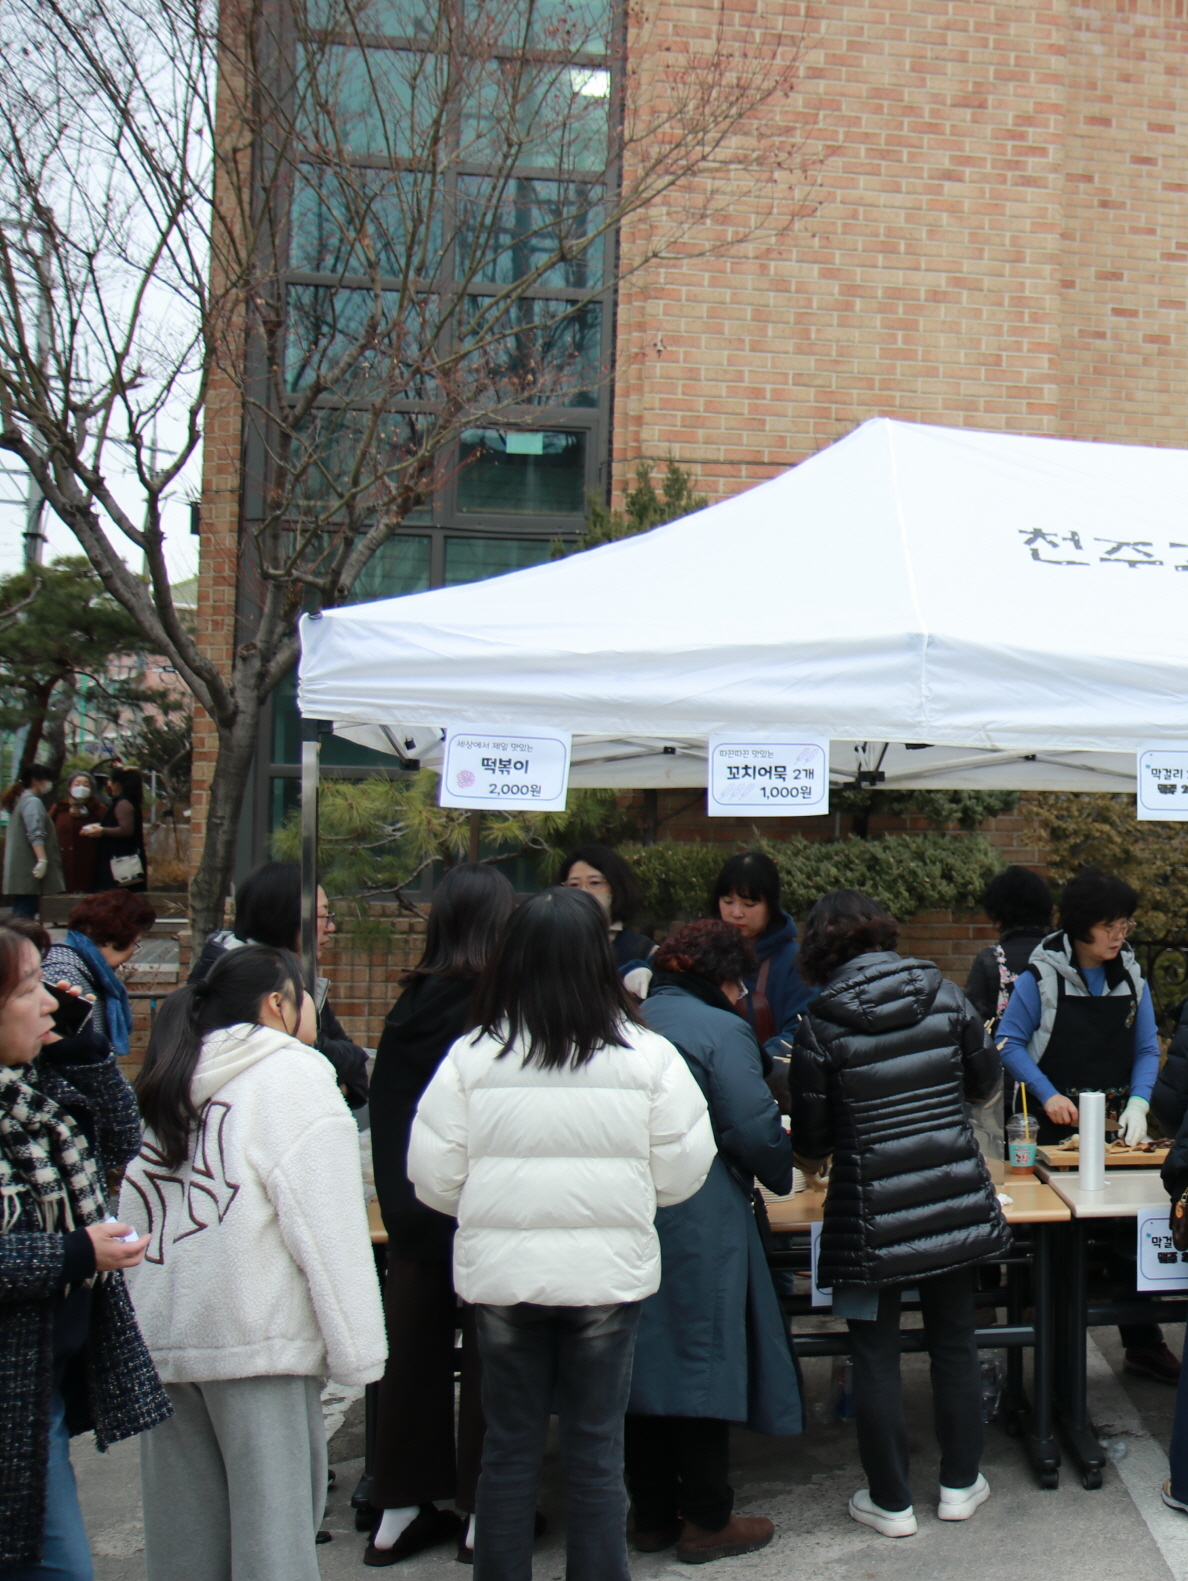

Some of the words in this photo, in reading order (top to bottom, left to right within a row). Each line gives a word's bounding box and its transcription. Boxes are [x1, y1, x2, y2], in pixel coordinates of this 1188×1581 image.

[457, 740, 490, 750] 세상에서
[492, 742, 508, 751] 제일
[510, 743, 534, 753] 맛있는
[719, 749, 749, 759] 따끈따끈
[751, 749, 774, 759] 맛있는
[481, 757, 529, 775] 떡볶이
[727, 765, 787, 782] 꼬치어묵
[793, 768, 814, 780] 2개
[1151, 768, 1183, 780] 막걸리
[489, 783, 542, 797] 2,000원
[760, 786, 812, 800] 1,000원
[1151, 1236, 1173, 1249] 막걸
